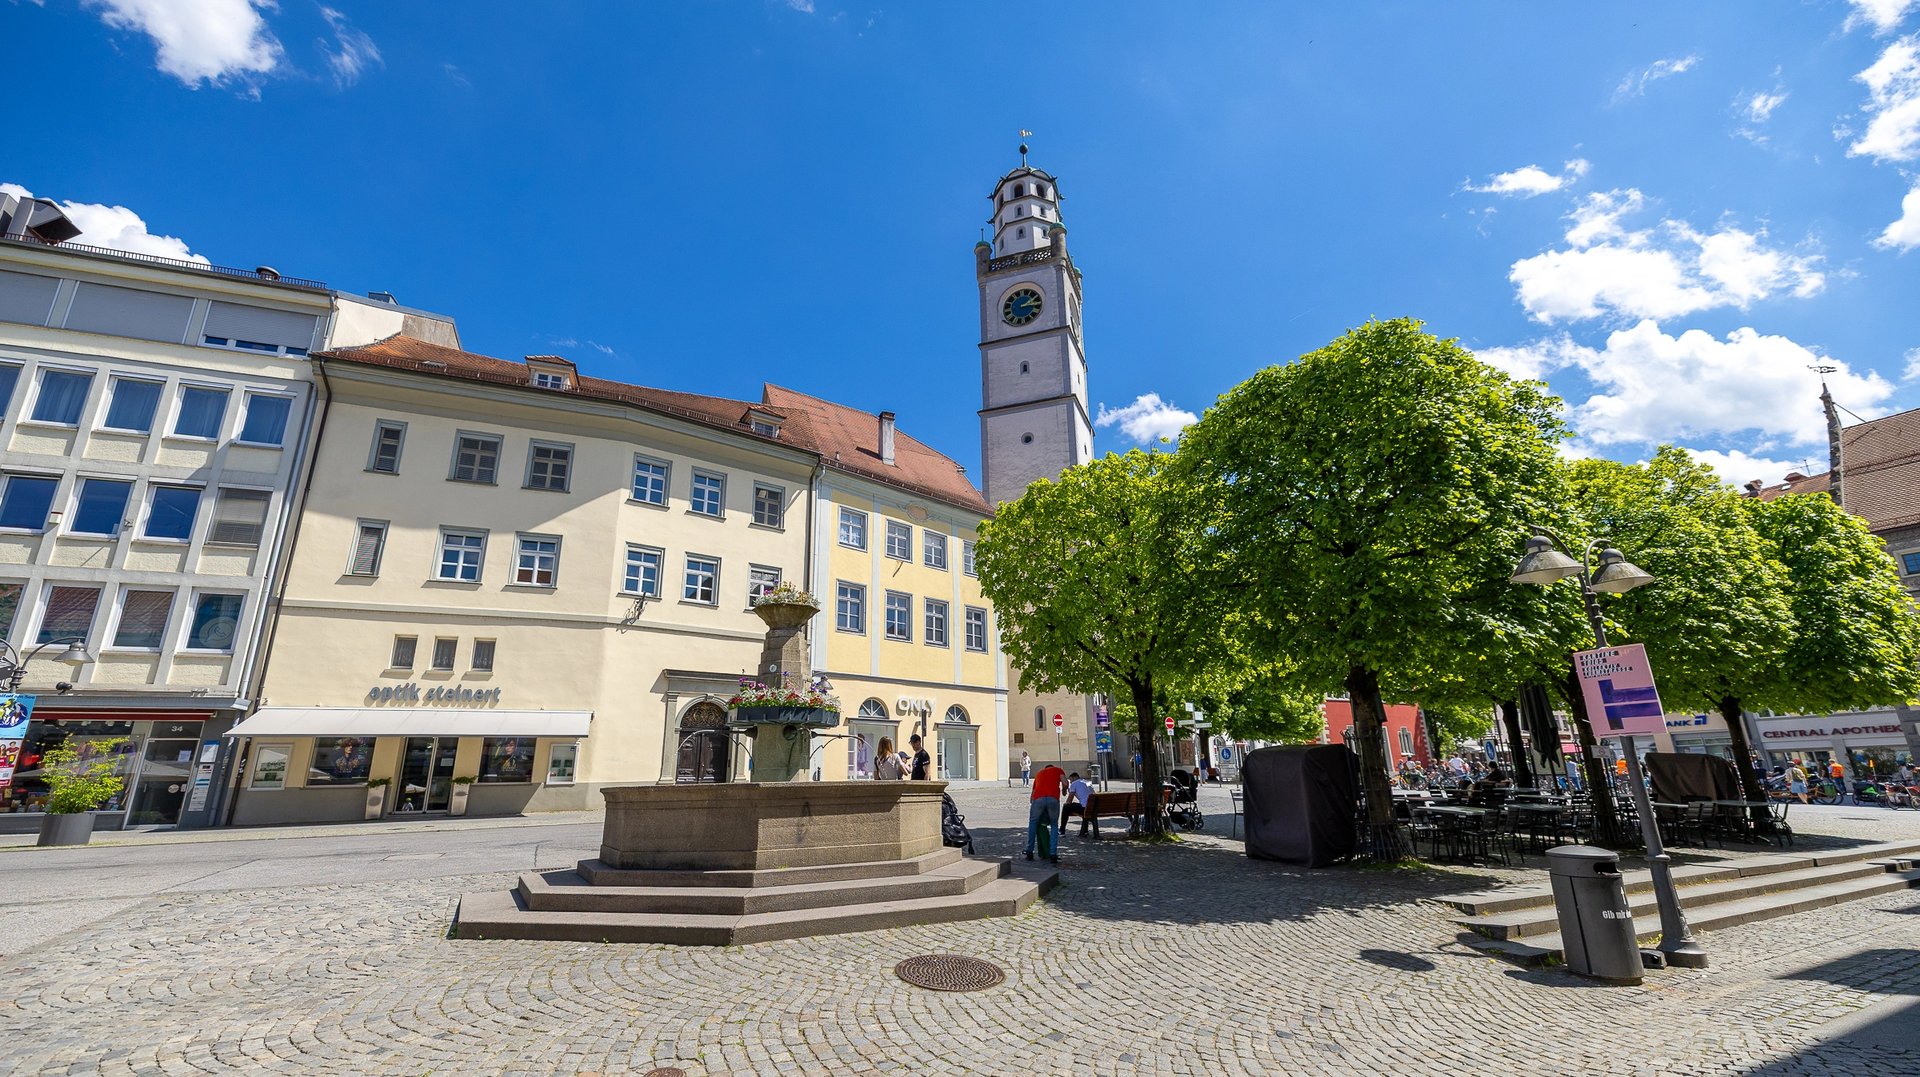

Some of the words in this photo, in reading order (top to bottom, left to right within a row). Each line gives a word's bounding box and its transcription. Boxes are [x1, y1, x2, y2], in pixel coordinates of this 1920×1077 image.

[369, 682, 420, 704] optik
[427, 684, 500, 703] steinert
[898, 697, 935, 712] ONLY
[1762, 728, 1828, 739] CENTRAL
[1831, 724, 1903, 736] APOTHEK
[1602, 910, 1615, 919] Gib
